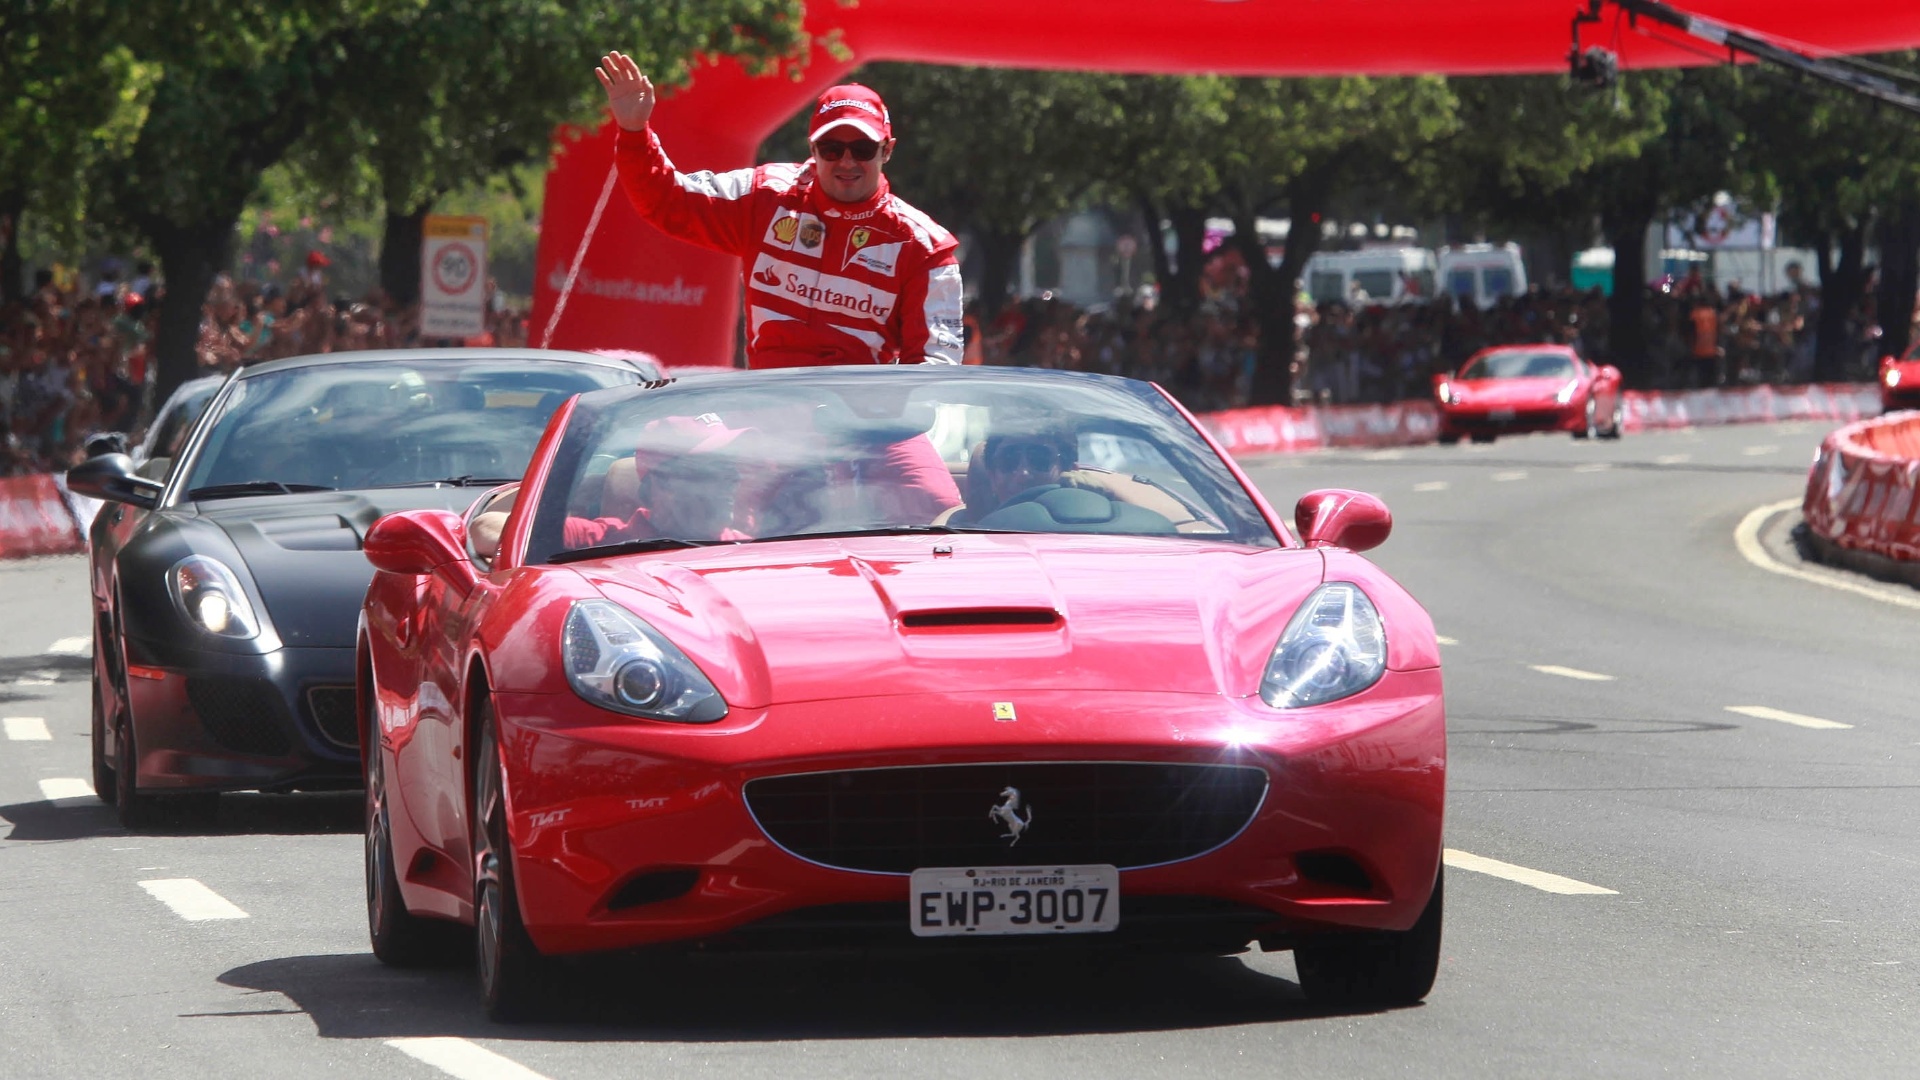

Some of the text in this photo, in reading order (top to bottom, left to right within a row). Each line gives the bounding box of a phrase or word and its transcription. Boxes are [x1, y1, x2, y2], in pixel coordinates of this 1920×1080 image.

[785, 273, 890, 317] Santander
[1009, 877, 1021, 886] DE
[1024, 876, 1065, 886] JANEIRO
